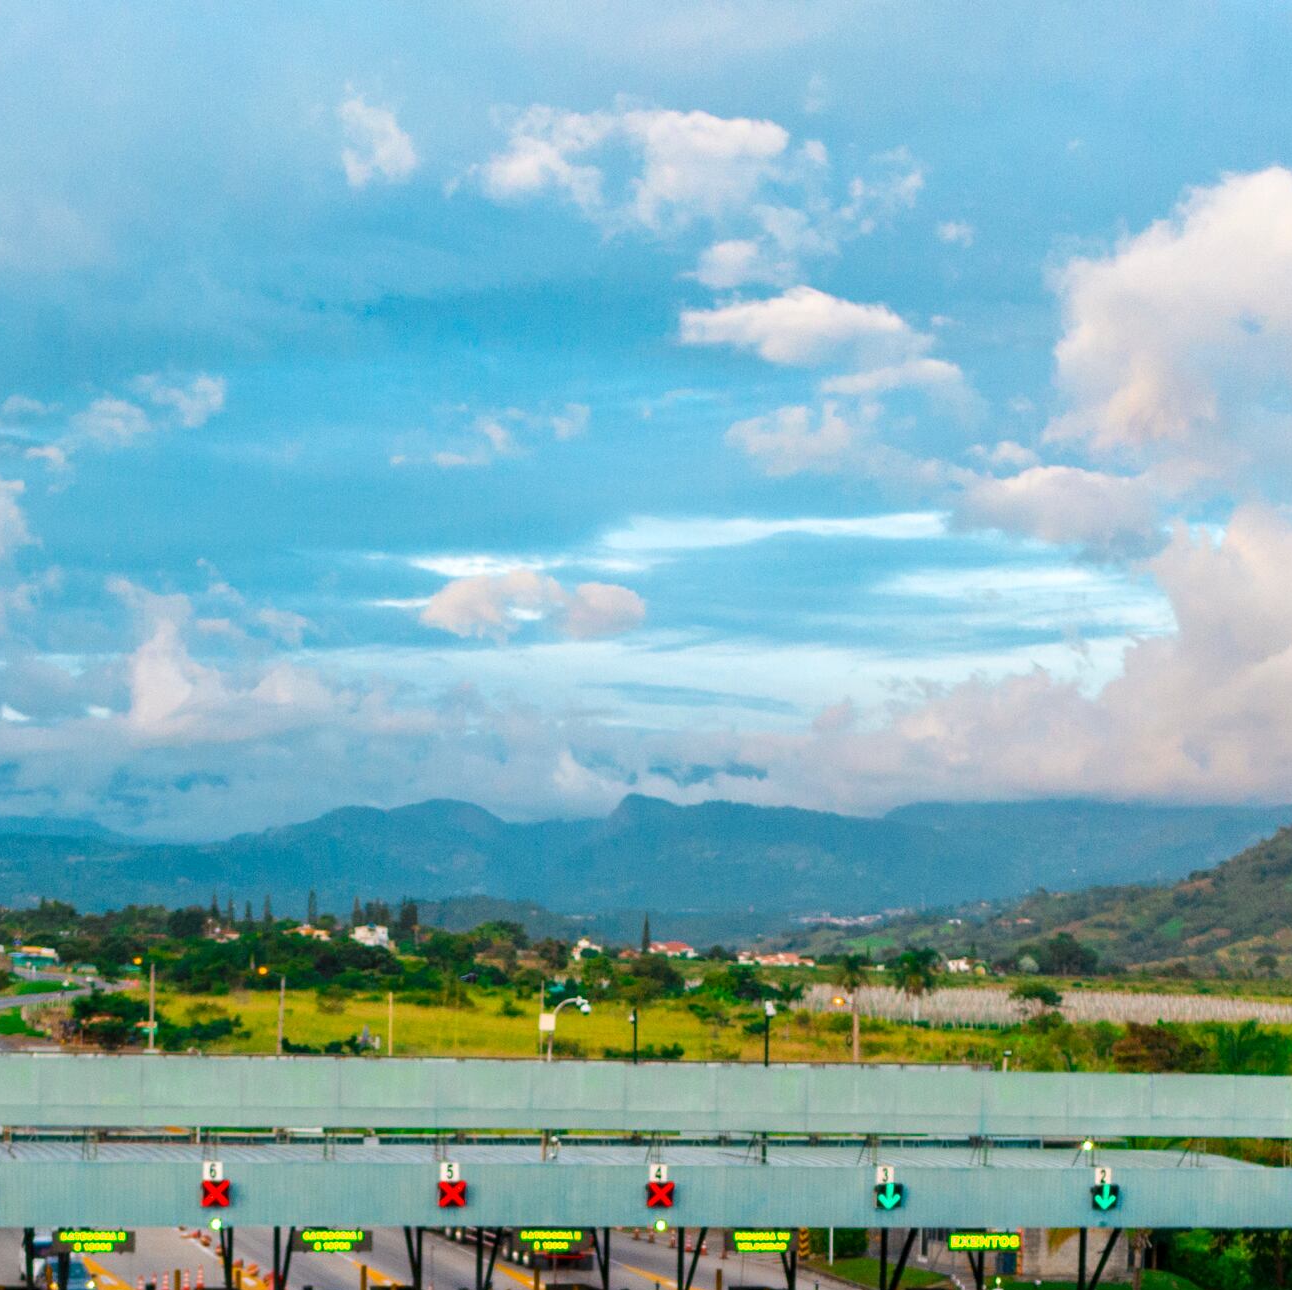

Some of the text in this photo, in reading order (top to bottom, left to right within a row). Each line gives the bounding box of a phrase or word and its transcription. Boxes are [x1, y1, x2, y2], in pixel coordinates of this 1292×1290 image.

[210, 1163, 217, 1178] 6
[447, 1164, 453, 1179] 5
[655, 1166, 662, 1179] 4
[883, 1168, 889, 1182] 3
[1100, 1169, 1106, 1184] 2
[950, 1234, 1020, 1248] EXENTOS
